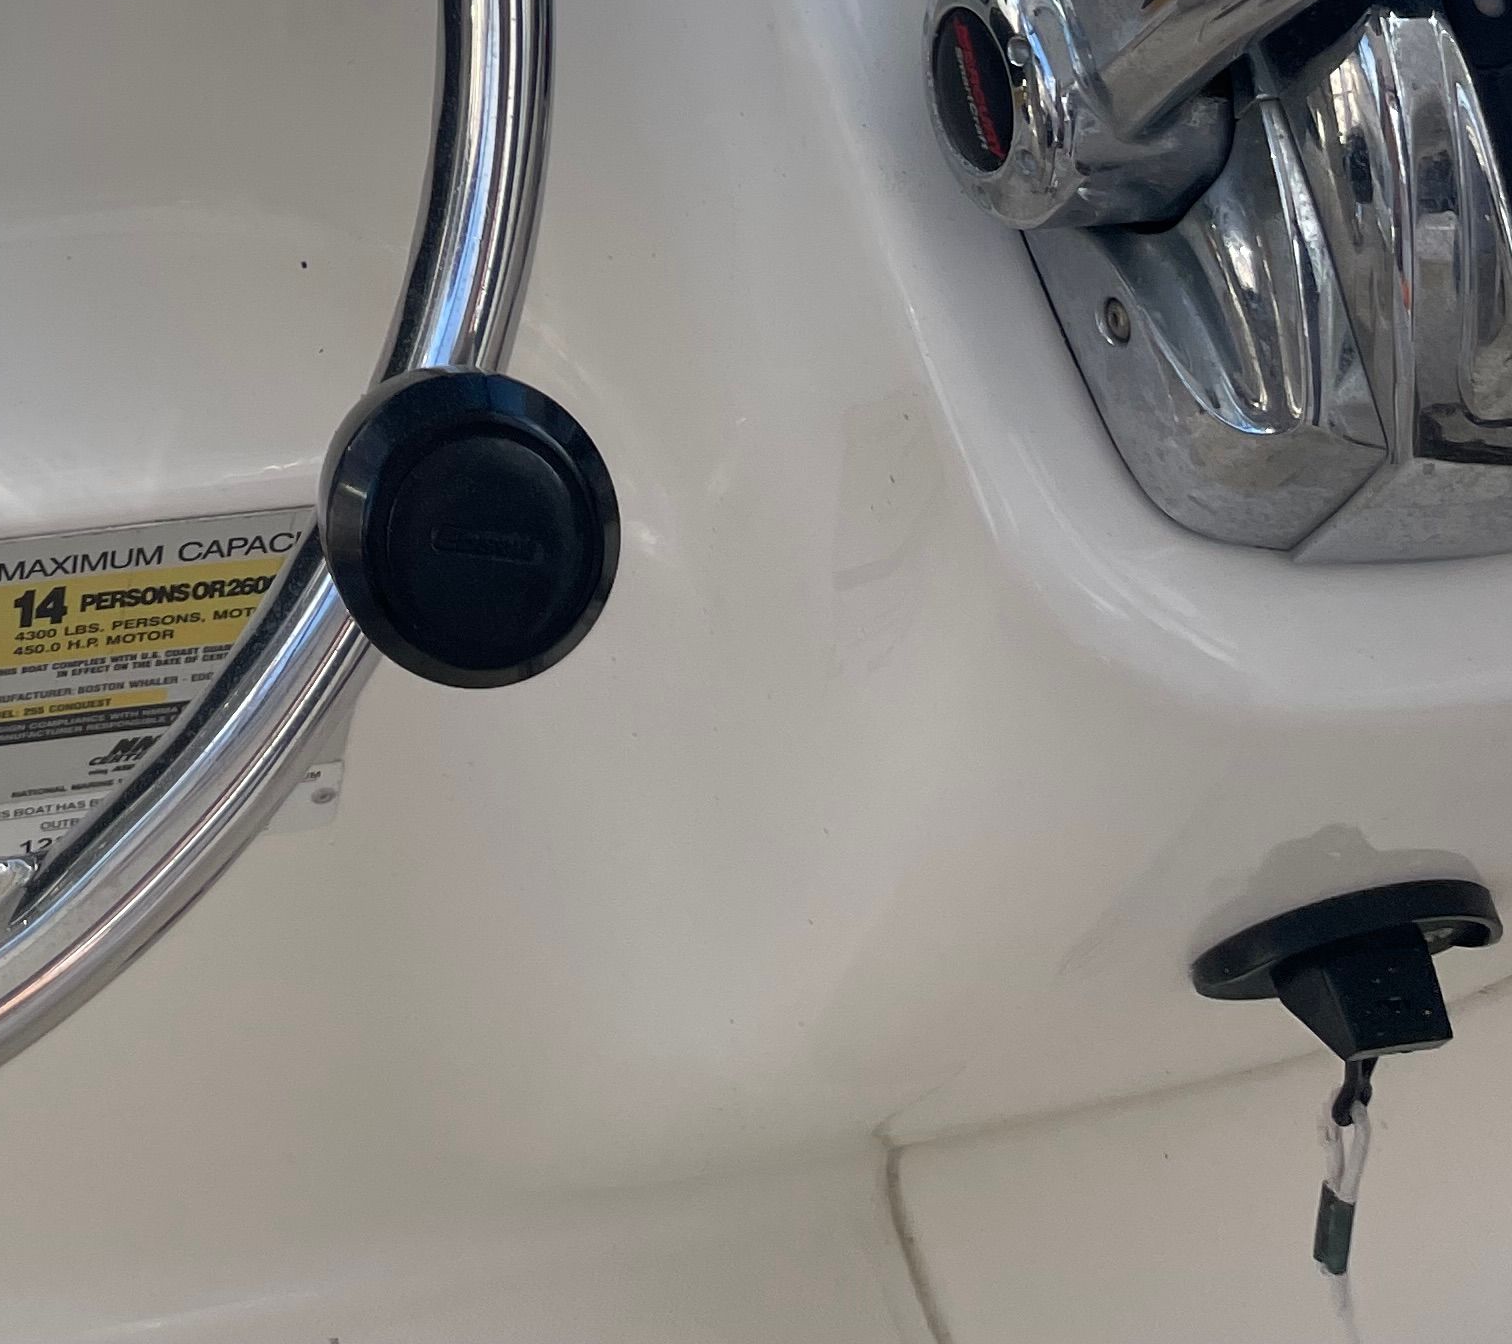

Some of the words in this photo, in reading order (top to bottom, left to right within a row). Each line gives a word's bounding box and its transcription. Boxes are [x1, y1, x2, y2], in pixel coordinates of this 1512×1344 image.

[13, 586, 67, 629] 14
[79, 582, 194, 613] PERSONS
[192, 579, 225, 600] OR
[14, 627, 58, 642] 4300
[64, 622, 105, 637] LBS.
[13, 642, 61, 656] 450.0
[67, 637, 99, 650] H.P.
[105, 629, 175, 645] MOTOR
[21, 663, 48, 674] BOAT
[52, 656, 107, 671] COMPLIES
[110, 653, 137, 663] WITH
[77, 681, 125, 695] BOSTON
[129, 675, 178, 689] WHALER
[23, 706, 45, 716] 255
[48, 698, 112, 714] CONQUEST
[13, 804, 52, 817] BOAT
[55, 799, 87, 811] HAS
